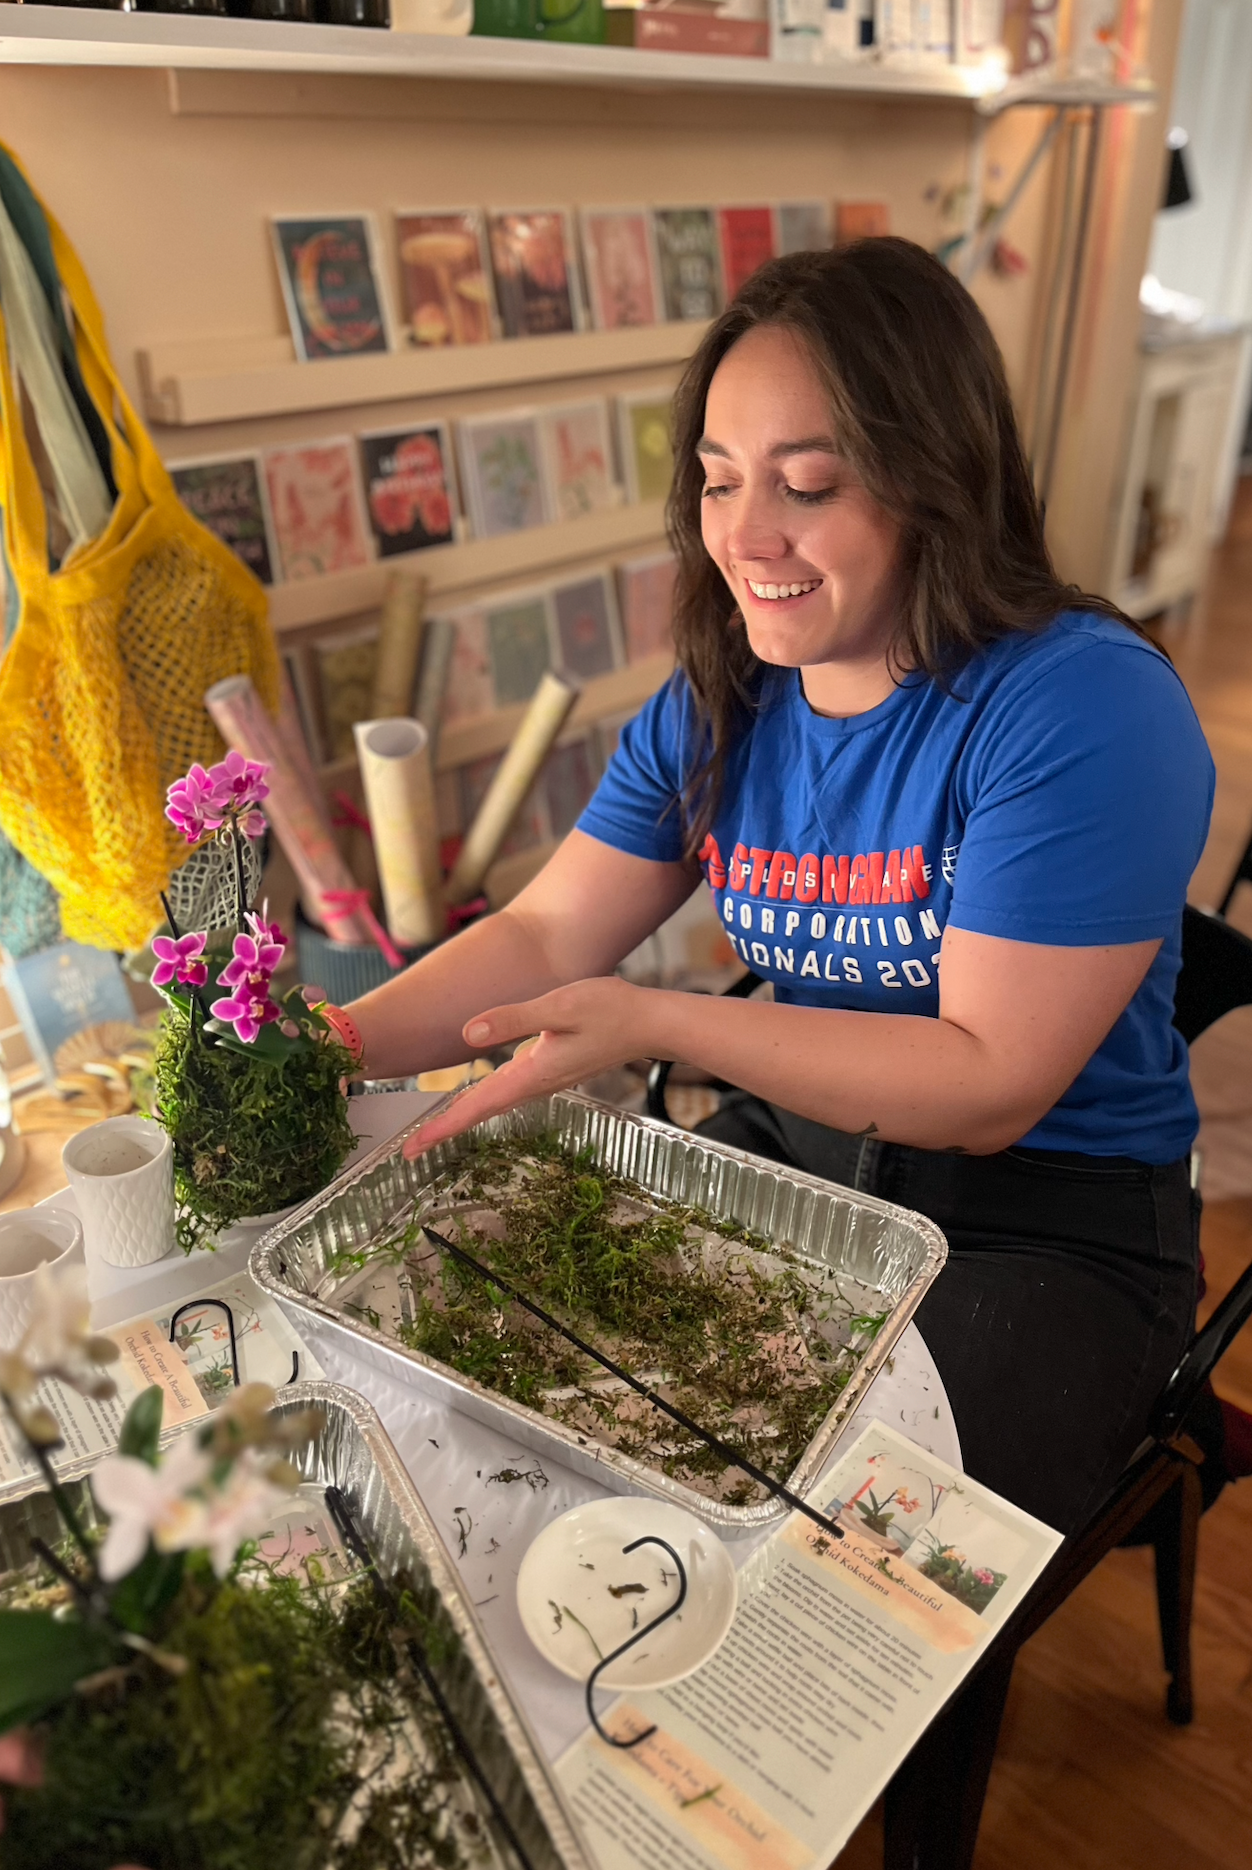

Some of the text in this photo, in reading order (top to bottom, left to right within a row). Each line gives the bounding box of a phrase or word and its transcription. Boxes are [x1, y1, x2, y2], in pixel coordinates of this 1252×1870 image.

[724, 897, 942, 946] CORPORATION
[124, 1335, 143, 1358] Orchid
[140, 1329, 192, 1409] How to Create A Beautiful
[804, 1532, 892, 1596] Ohid Kokedama
[839, 1539, 851, 1549] to
[850, 1545, 885, 1572] Create
[895, 1575, 943, 1612] Beautiful
